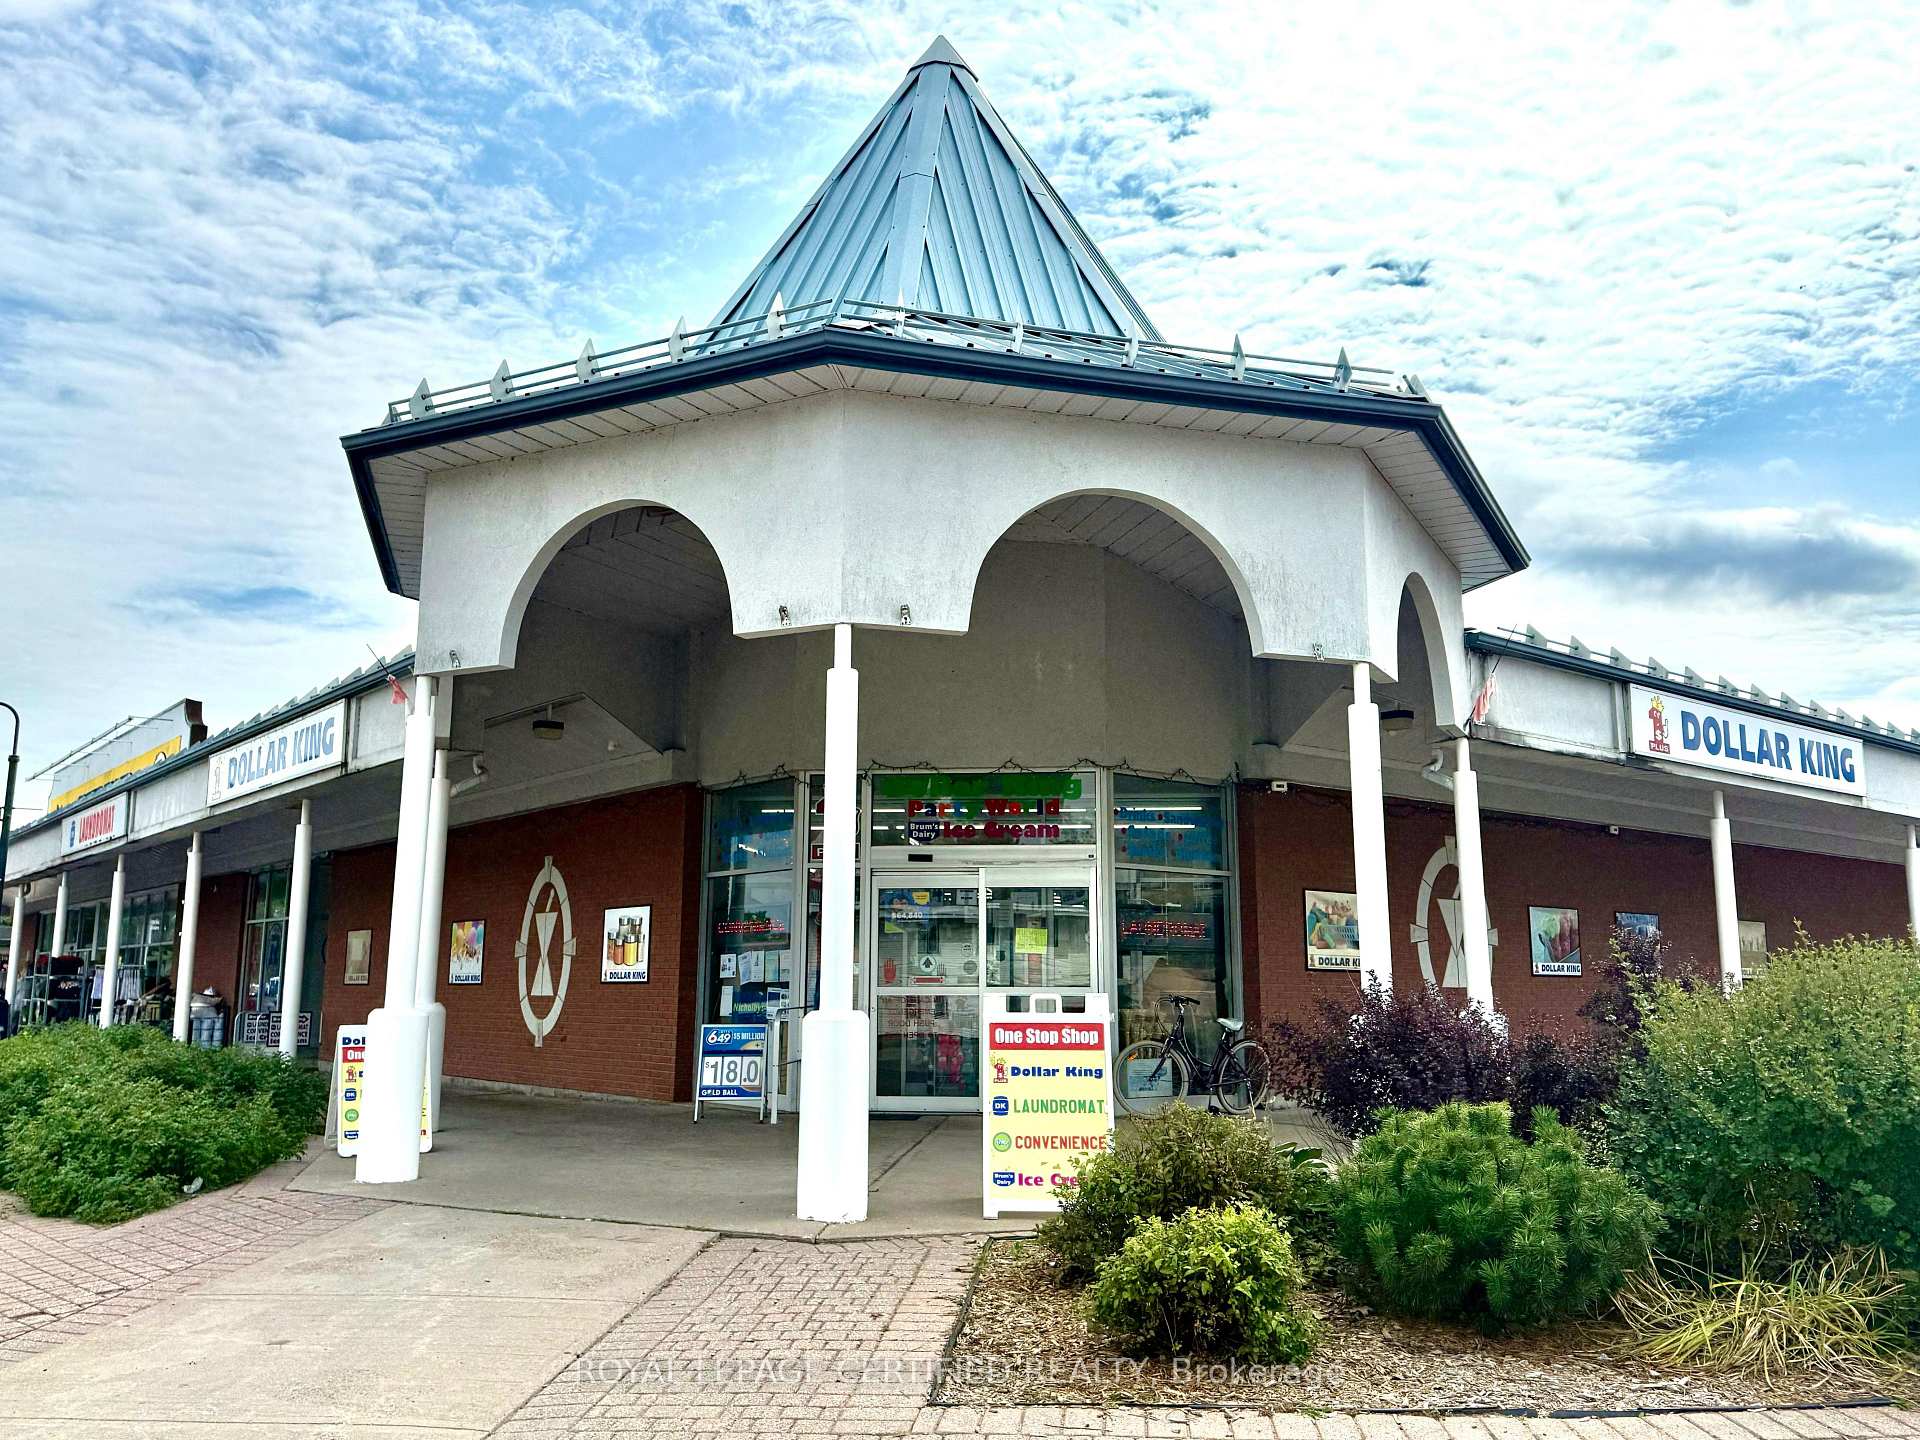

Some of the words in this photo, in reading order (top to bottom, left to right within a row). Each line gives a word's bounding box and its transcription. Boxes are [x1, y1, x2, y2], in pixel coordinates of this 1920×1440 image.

[227, 737, 287, 789] DOLLAR
[293, 717, 335, 766] KING
[1681, 710, 1793, 771] DOLLAR
[1798, 737, 1856, 783] KING
[910, 823, 939, 831] Brum's
[943, 821, 977, 838] Ice
[983, 821, 1060, 838] Cream
[912, 831, 936, 840] Dairy
[1318, 957, 1350, 966] DOLLAR
[1541, 964, 1565, 972] DOLLAR
[1567, 965, 1580, 973] KING
[609, 972, 631, 980] DOLLAR
[633, 972, 646, 980] KING
[342, 1036, 366, 1046] Dol
[995, 1028, 1023, 1044] One
[1026, 1028, 1058, 1045] Stop
[1062, 1028, 1098, 1045] Shop
[1011, 1066, 1060, 1077] Dollar
[1065, 1066, 1103, 1079] King
[1013, 1099, 1105, 1114] LAUNDROMAT
[1015, 1135, 1107, 1150] CONVENIENCE
[1017, 1173, 1044, 1187] Ice
